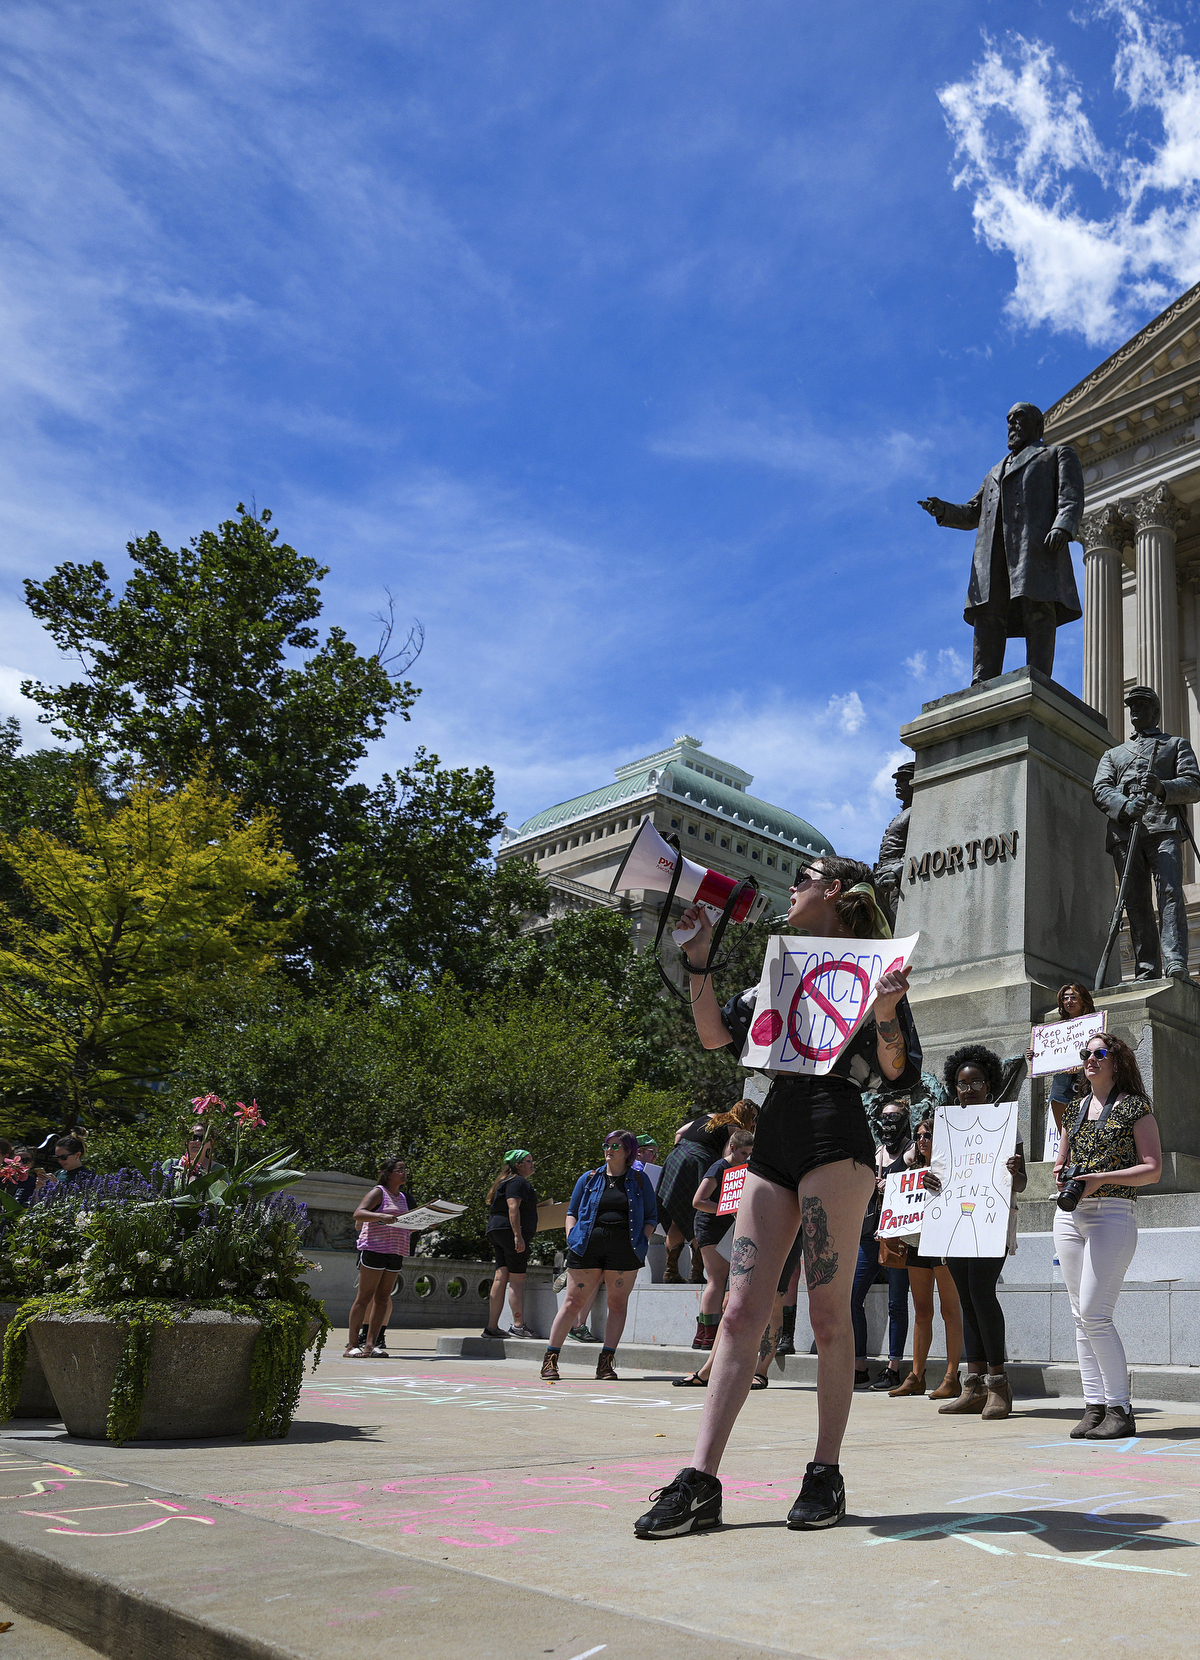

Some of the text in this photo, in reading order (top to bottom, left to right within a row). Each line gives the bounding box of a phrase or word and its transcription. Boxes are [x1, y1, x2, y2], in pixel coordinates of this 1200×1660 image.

[908, 830, 1019, 880] MORTON
[777, 951, 883, 1004] FORCED
[1042, 1030, 1085, 1048] RELIGION
[965, 1134, 983, 1147] NO
[954, 1152, 994, 1168] UTERUS
[954, 1168, 973, 1181] NO
[723, 1179, 743, 1192] BANS
[932, 1184, 996, 1223] OPINION
